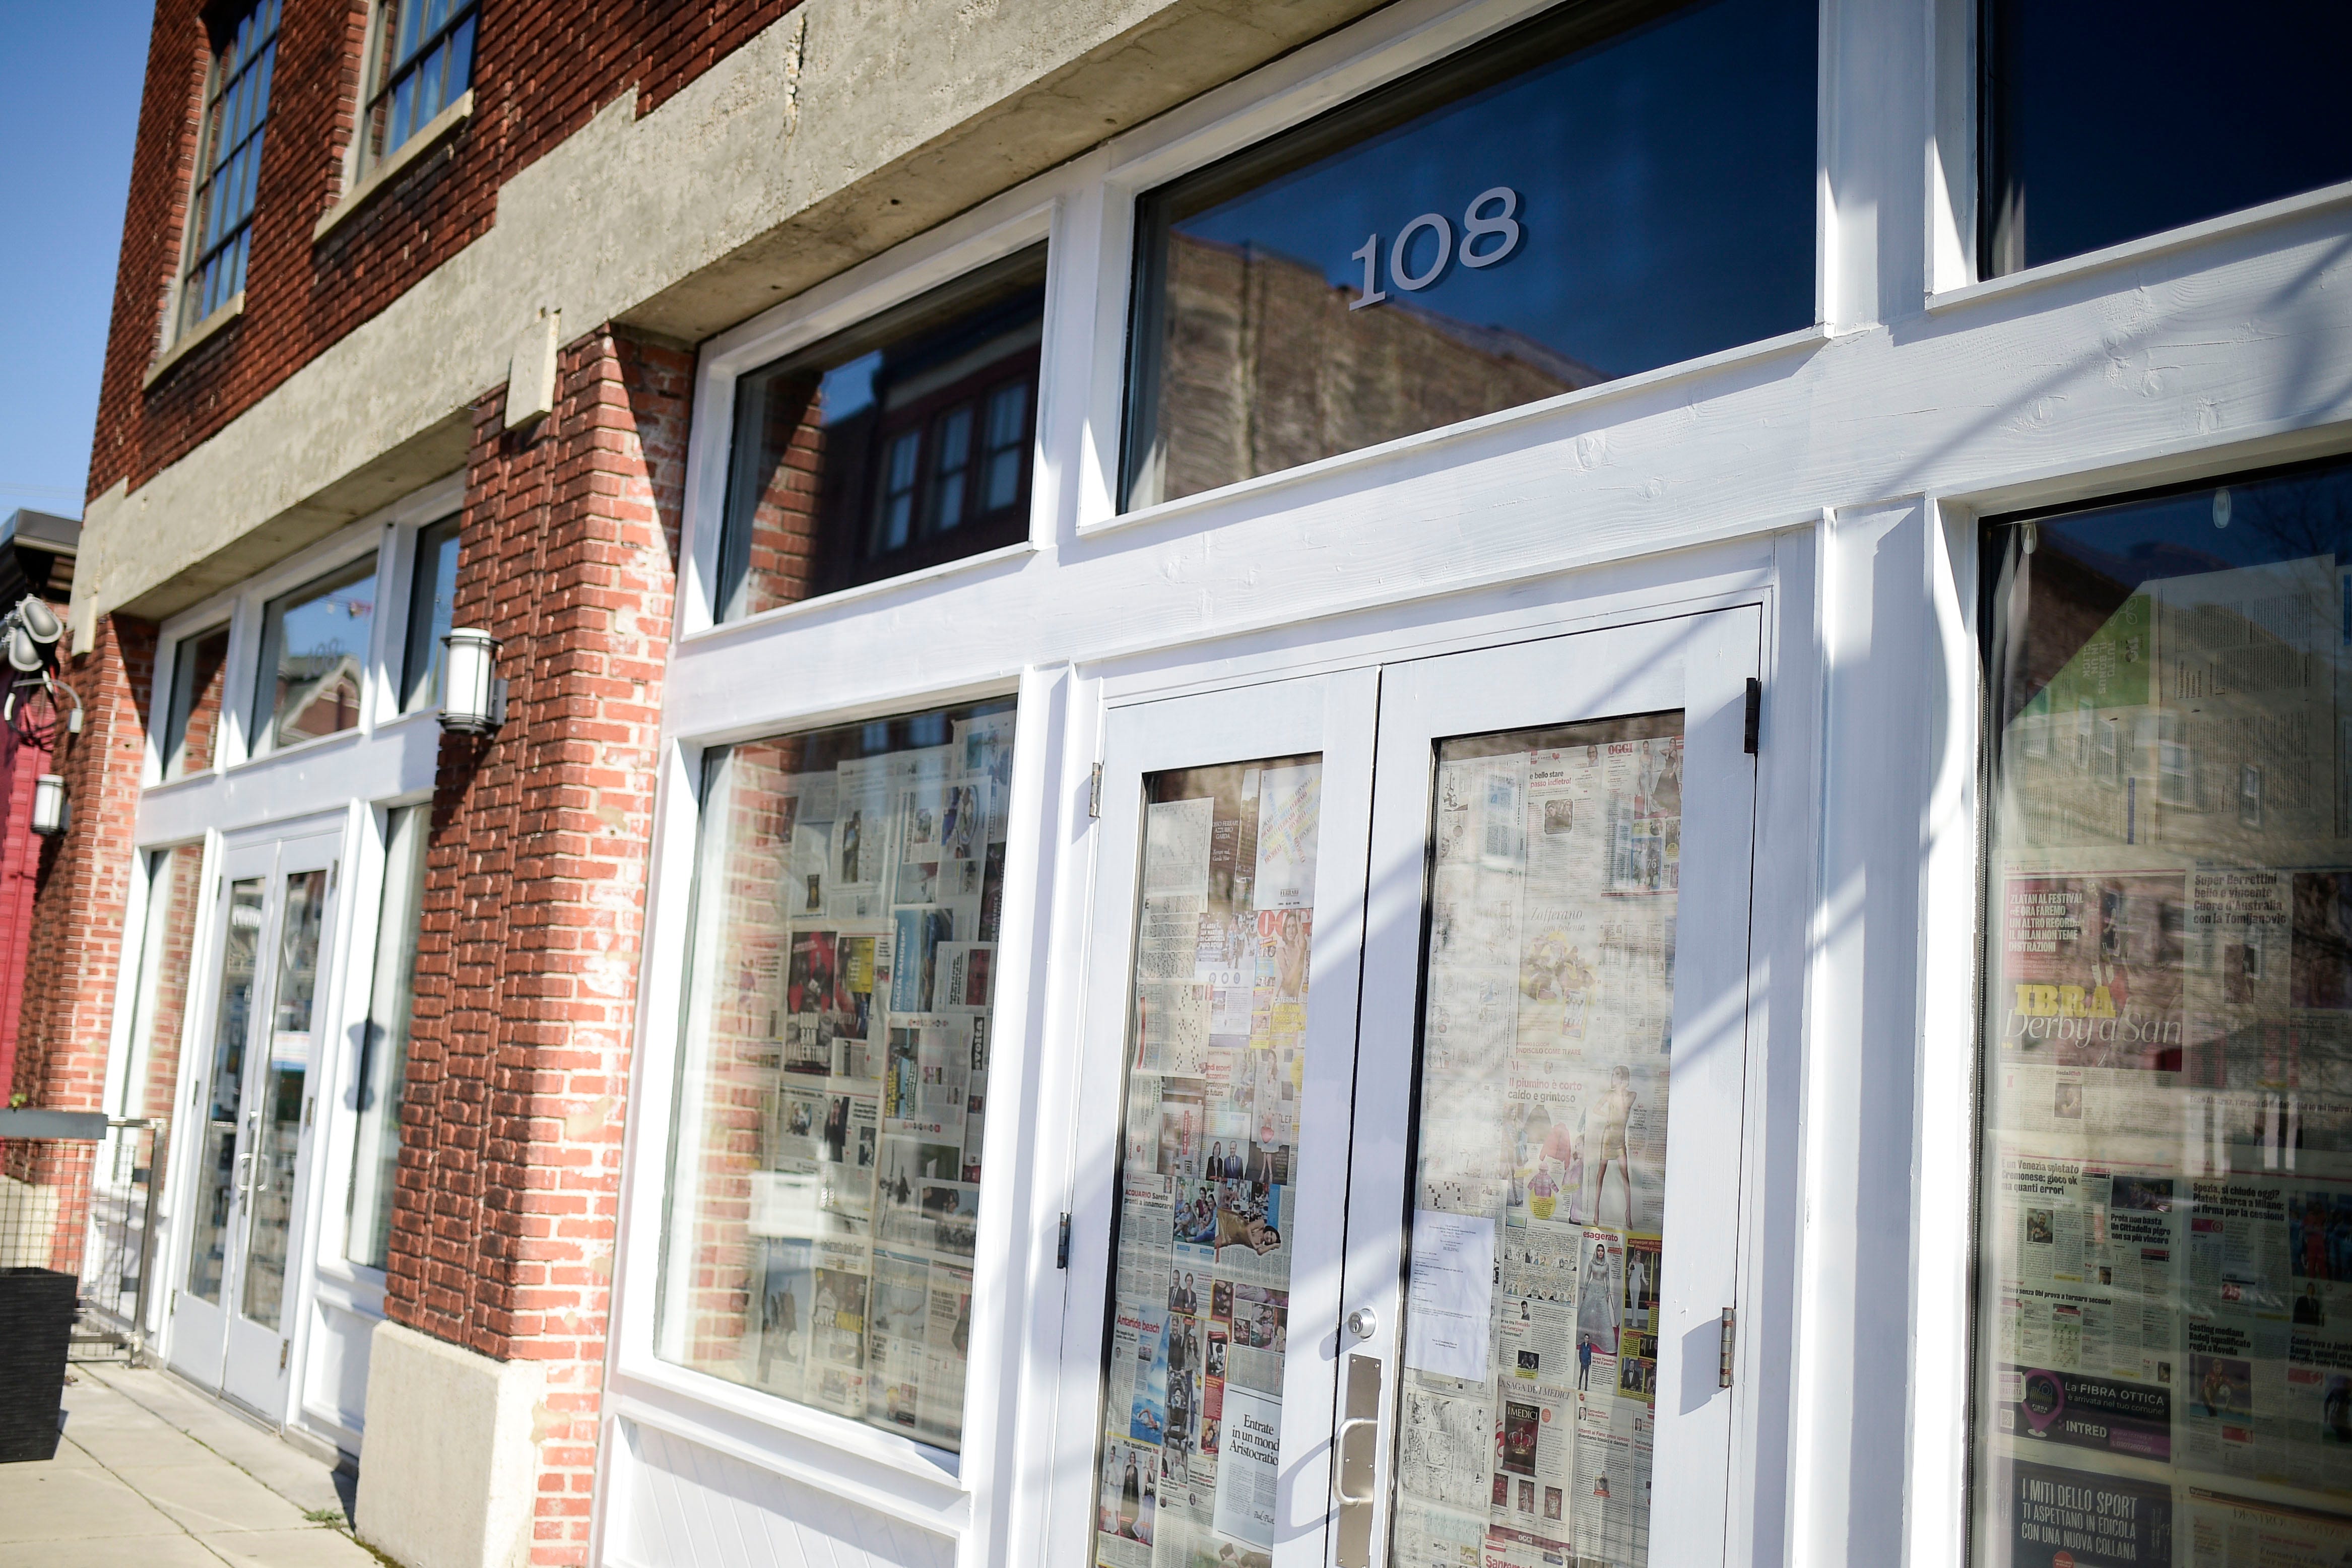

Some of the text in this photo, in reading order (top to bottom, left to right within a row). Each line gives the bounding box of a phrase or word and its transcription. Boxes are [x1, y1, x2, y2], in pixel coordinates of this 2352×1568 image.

[1349, 187, 1519, 311] 108
[2083, 645, 2091, 678] CLICK
[2098, 656, 2107, 694] BONUS
[1608, 743, 1633, 755] OGGI
[1647, 859, 1657, 869] 76
[2194, 873, 2277, 887] Super Berrettini
[2010, 893, 2083, 905] ZLATAN AL FESTIVAL
[2194, 887, 2272, 898] bello vincente
[2021, 906, 2065, 916] ORA FAREMO
[2194, 899, 2282, 911] Cuore d'Australia
[1531, 907, 1583, 925] Zafferano
[2009, 918, 2045, 928] UN ALTRO
[2193, 913, 2222, 924] con la
[1558, 923, 1585, 935] polenta
[2017, 930, 2078, 940] MILAN NON TEME
[897, 927, 906, 979] SANDERO
[2008, 942, 2056, 952] DISTRAZIONI
[2015, 985, 2116, 1018] IBRA
[2003, 1009, 2182, 1048] Derby a San
[1516, 1078, 1549, 1089] piumino
[1559, 1081, 1582, 1091] corto
[1508, 1090, 1531, 1099] caldo
[1540, 1092, 1576, 1102] grintoso
[2007, 1160, 2079, 1174] un Venezia spietato
[2001, 1170, 2077, 1185] Cremonese: gioco ok
[1126, 1189, 1151, 1198] ACQUARIO
[2014, 1183, 2064, 1195] quanti errori
[2193, 1183, 2280, 1200] Spezia, chiude oggi?
[1143, 1200, 1173, 1210] innamorarvi
[2193, 1193, 2284, 1210] Platek sbarca Milano:
[2111, 1213, 2162, 1226] Proia non basta
[2201, 1204, 2285, 1222] firma per la cessione
[1583, 1231, 1618, 1242] esagerato
[2111, 1222, 2171, 1237] Un Cittadella pigro
[2131, 1234, 2169, 1245] più vincere
[2044, 1292, 2060, 1300] prova
[2066, 1293, 2088, 1303] tornare
[2088, 1296, 2111, 1306] secondo
[1117, 1314, 1159, 1334] Antartide beach
[2189, 1323, 2244, 1338] Casting mediana
[2189, 1342, 2238, 1356] regia Rovella
[2210, 1335, 2251, 1349] squalificato
[2290, 1335, 2326, 1349] Candreva
[1507, 1381, 1526, 1392] SAGA
[1543, 1388, 1570, 1400] MEDICI
[2065, 1382, 2165, 1406] La FIBRA OTTICA
[2074, 1394, 2101, 1405] arrivata
[2117, 1401, 2130, 1410] tuo
[2131, 1404, 2165, 1416] comune!
[1511, 1408, 1538, 1420] MEDICI
[1244, 1414, 1274, 1435] Entrate
[2066, 1420, 2107, 1439] INTRED
[1232, 1425, 1240, 1439] in
[1242, 1432, 1253, 1444] un
[1131, 1443, 1152, 1453] qualcuno
[2030, 1478, 2137, 1520] MITI DELLO SPORT
[2022, 1502, 2136, 1540] TI ASPETTANO IN EDICOLA
[1518, 1534, 1532, 1544] OGGI
[2021, 1523, 2136, 1561] CON UNA NUOVA COLLANA
